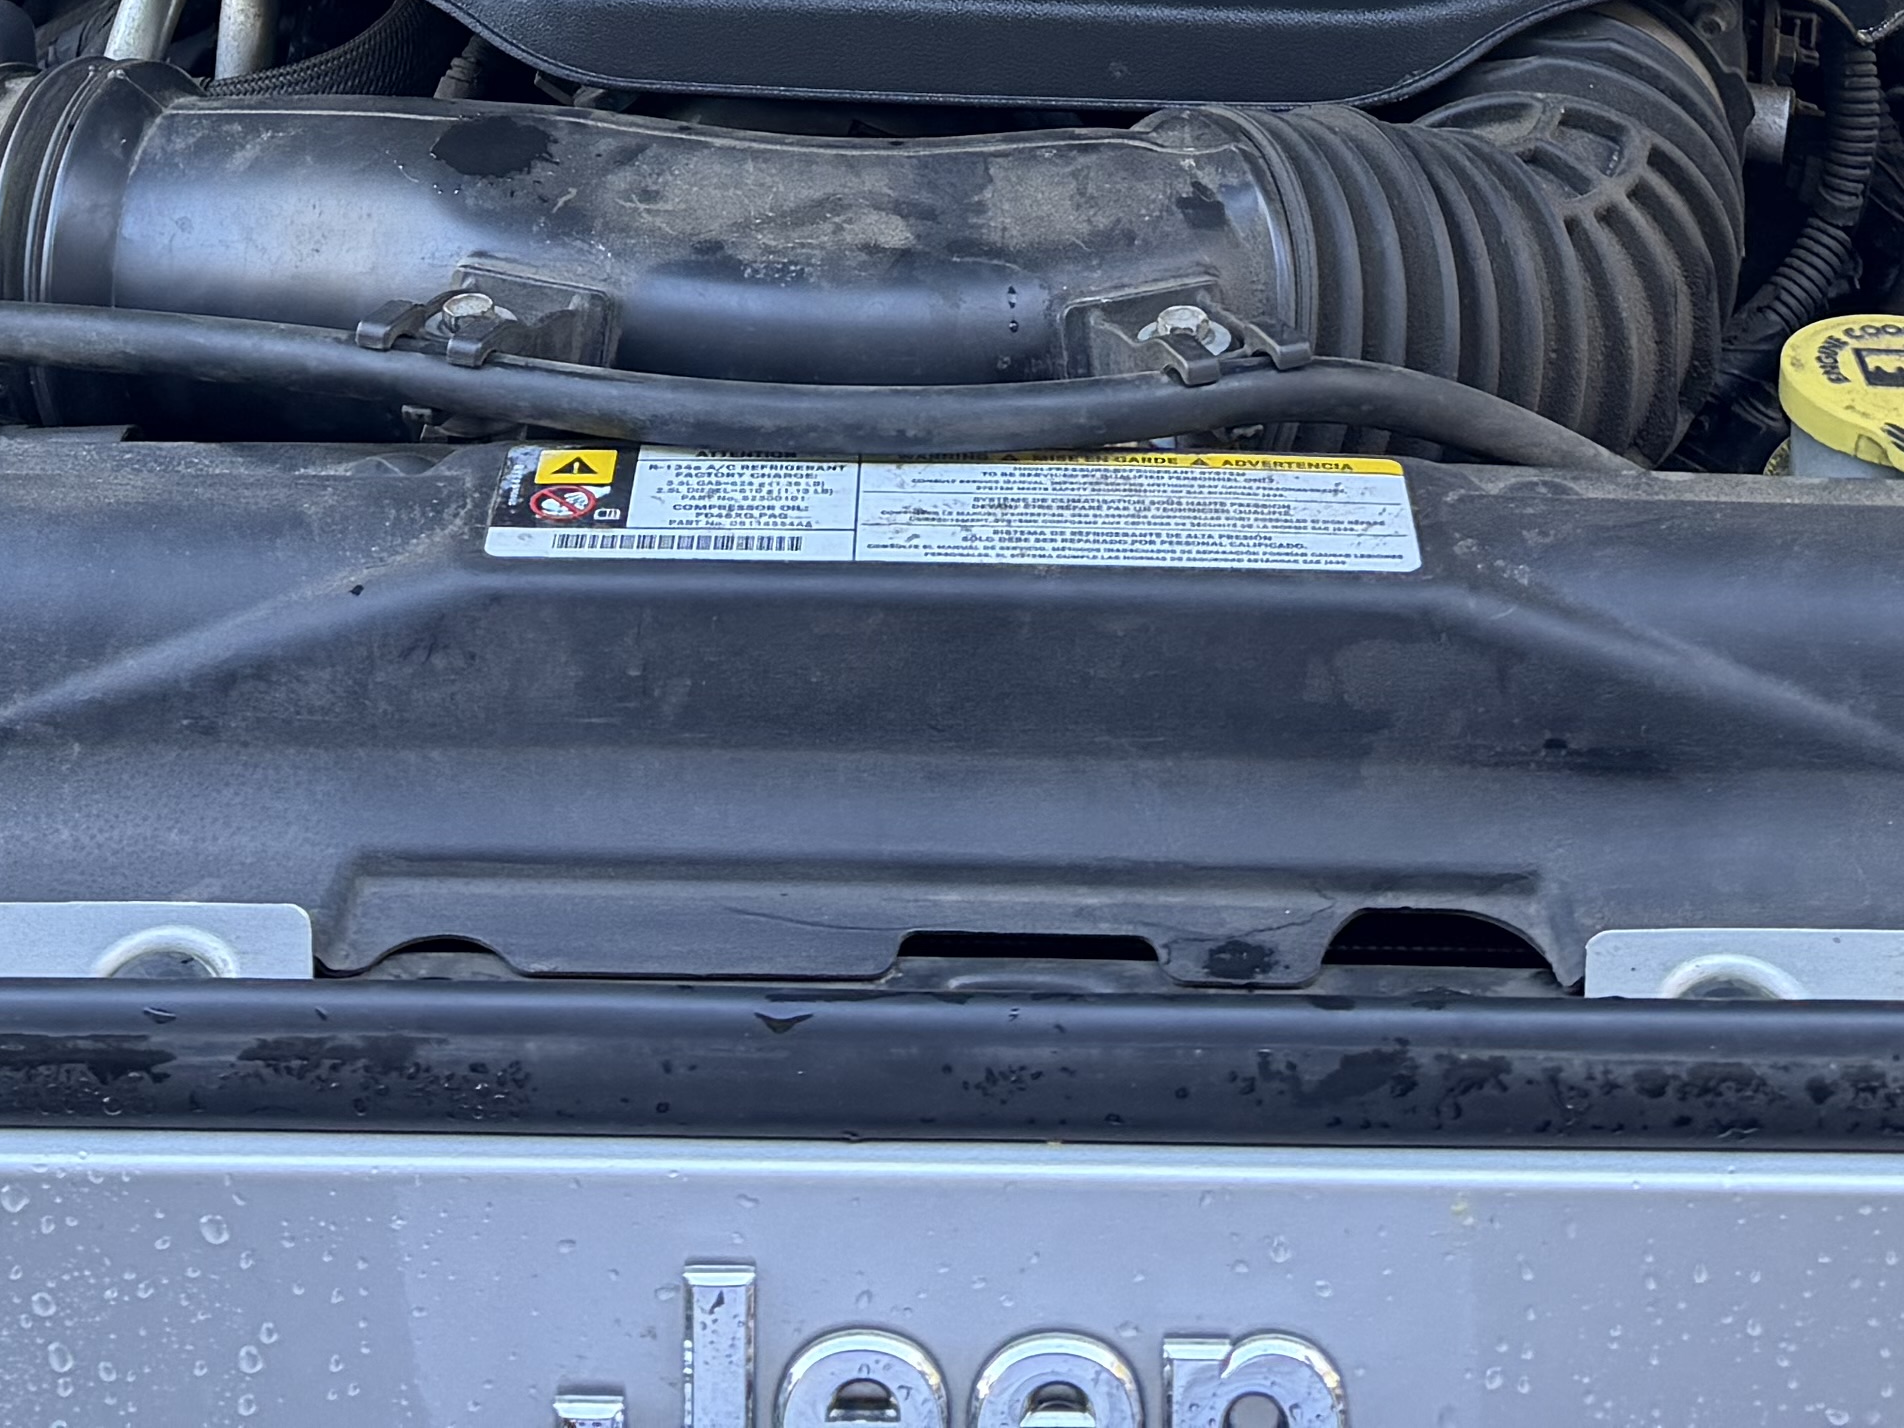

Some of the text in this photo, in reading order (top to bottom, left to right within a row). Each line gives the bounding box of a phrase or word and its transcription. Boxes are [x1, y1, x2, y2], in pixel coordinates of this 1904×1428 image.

[1815, 335, 1851, 385] ENGINE
[740, 464, 847, 472] REFRIGERANT
[1113, 456, 1179, 465] GARDE
[1221, 459, 1354, 472] ADVERTENCIA
[674, 472, 746, 480] FACTORY
[672, 503, 777, 513] COMPRESSOR
